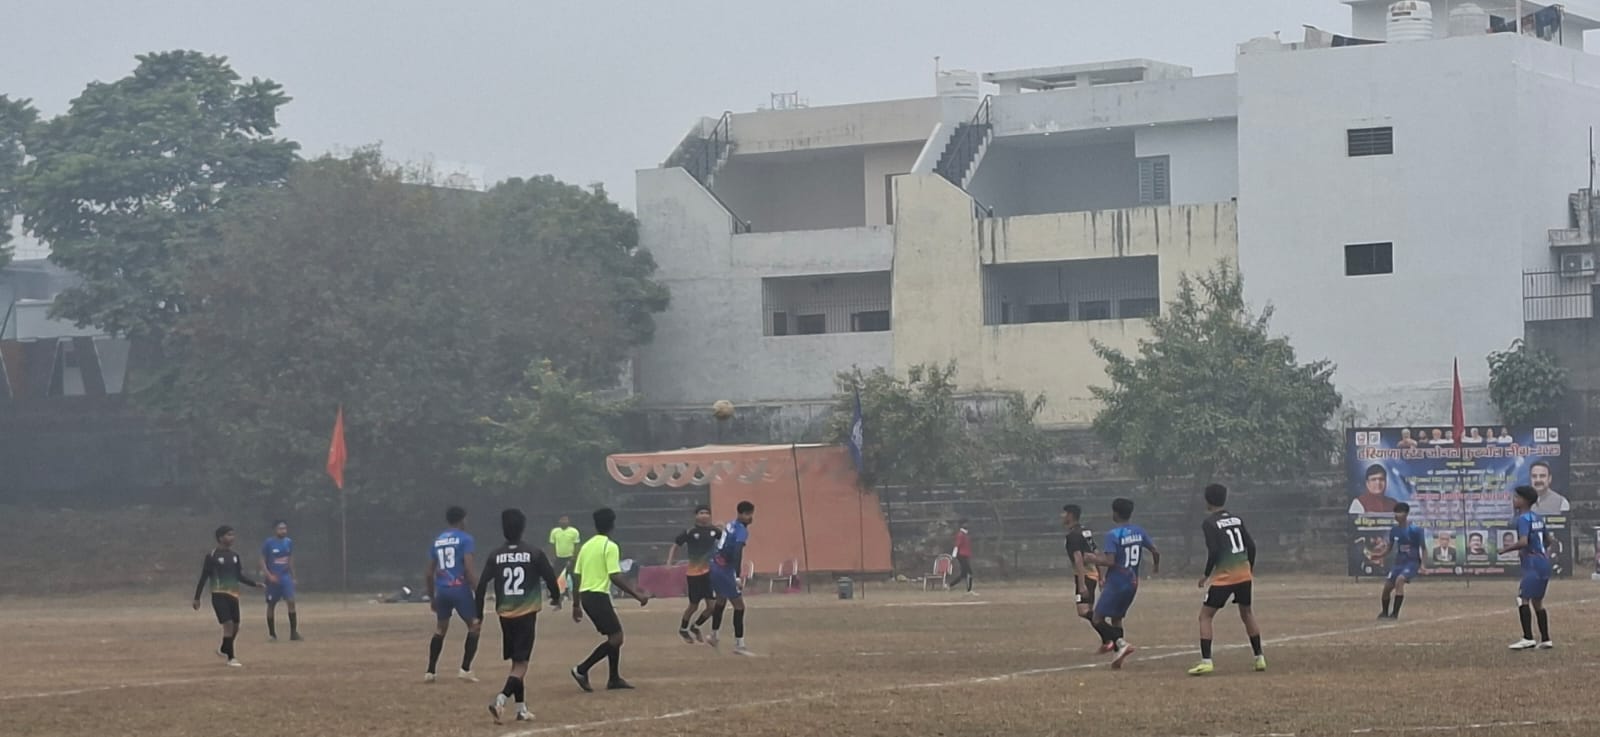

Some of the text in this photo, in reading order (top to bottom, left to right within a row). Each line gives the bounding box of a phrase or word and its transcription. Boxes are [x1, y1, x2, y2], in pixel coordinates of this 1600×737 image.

[1226, 527, 1244, 554] 11
[437, 546, 455, 570] 13
[1124, 545, 1140, 568] 19
[503, 566, 525, 596] 22
